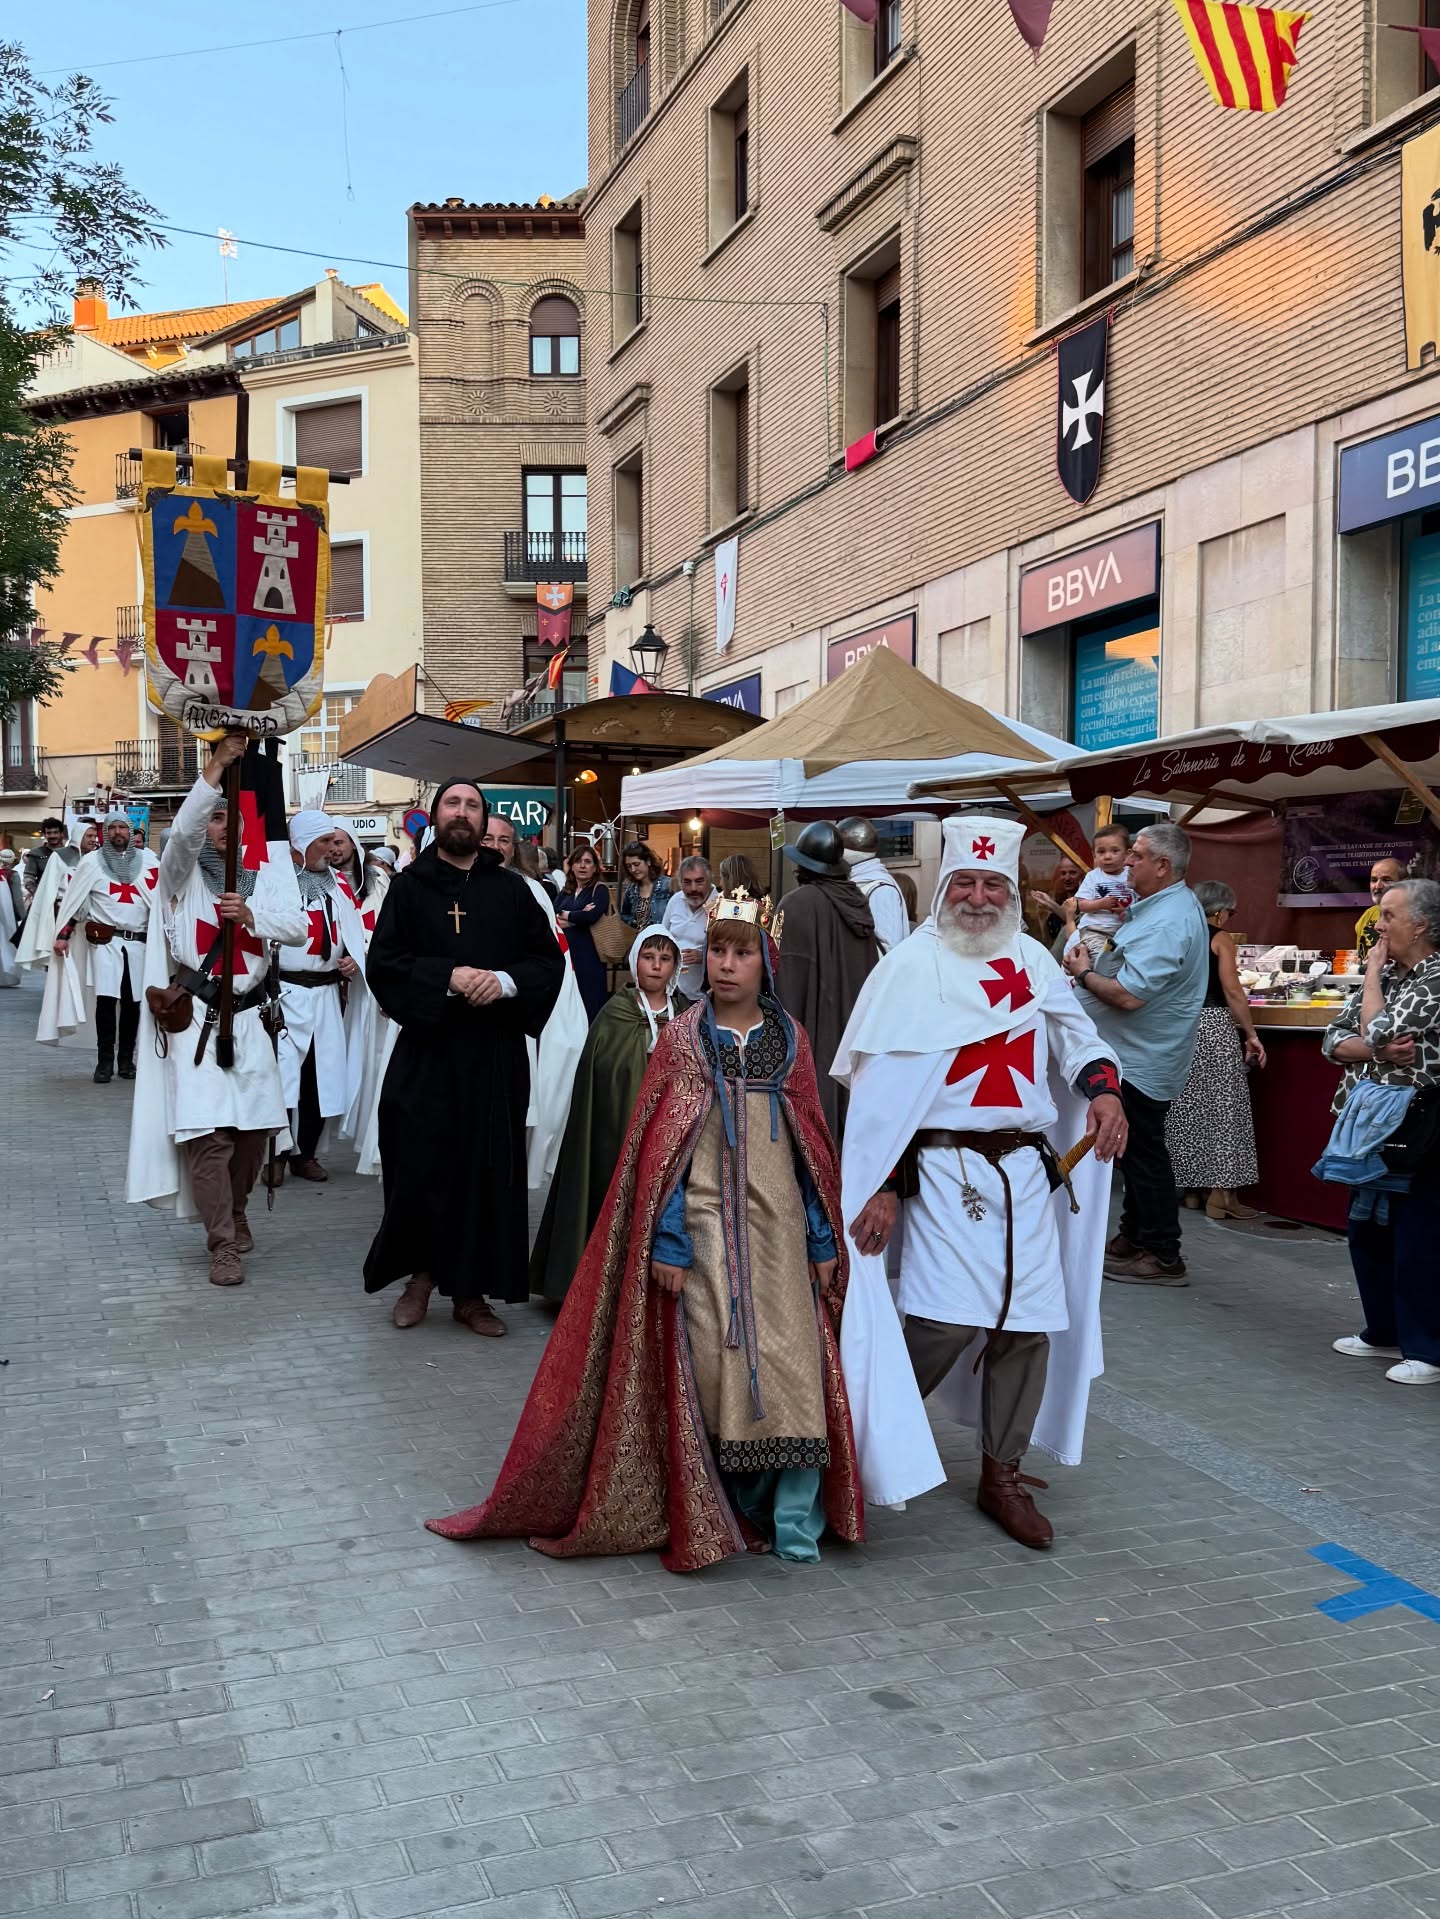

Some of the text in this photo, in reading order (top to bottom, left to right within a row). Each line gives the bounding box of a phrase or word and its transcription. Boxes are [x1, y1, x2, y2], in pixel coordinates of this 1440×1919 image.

[1048, 551, 1122, 613] BBVA
[1418, 593, 1434, 607] La
[1081, 694, 1092, 705] un
[1095, 684, 1126, 703] equipo
[1127, 680, 1144, 696] que
[1082, 679, 1092, 691] La
[1081, 706, 1096, 718] con
[1129, 706, 1155, 722] datos
[1133, 756, 1151, 786] La
[1230, 743, 1246, 768] de
[1258, 744, 1272, 764] la
